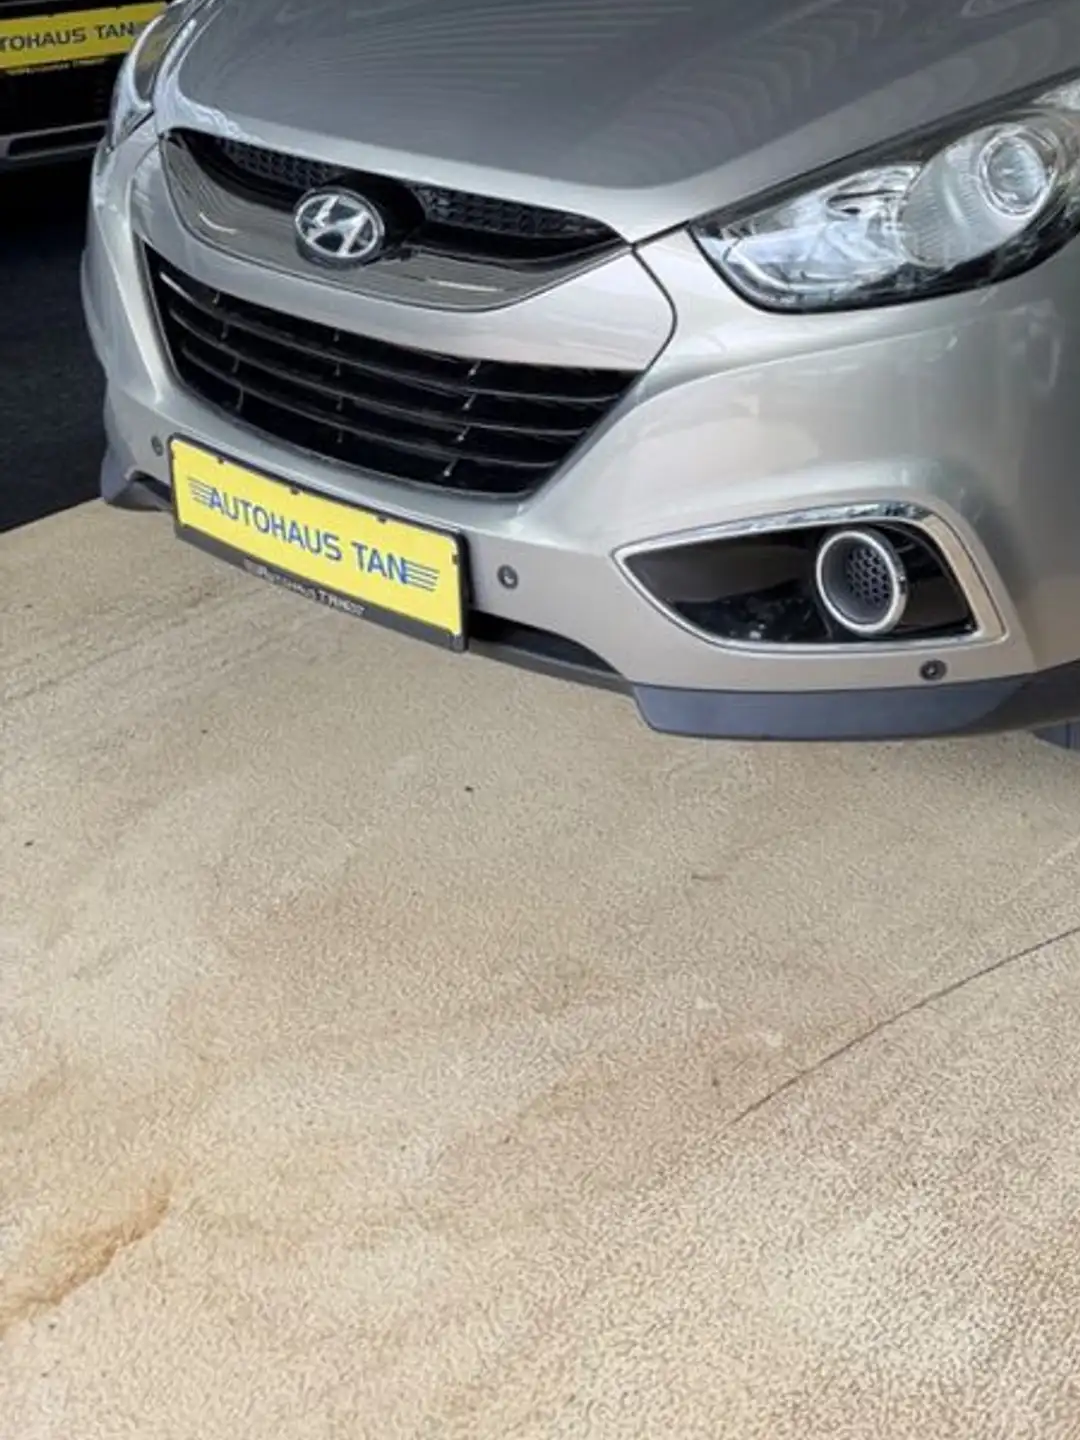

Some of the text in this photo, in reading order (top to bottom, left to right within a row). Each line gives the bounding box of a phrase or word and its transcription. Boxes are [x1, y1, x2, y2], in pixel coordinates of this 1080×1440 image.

[94, 21, 134, 41] TAN
[208, 487, 408, 585] AUTOHAUS TAN
